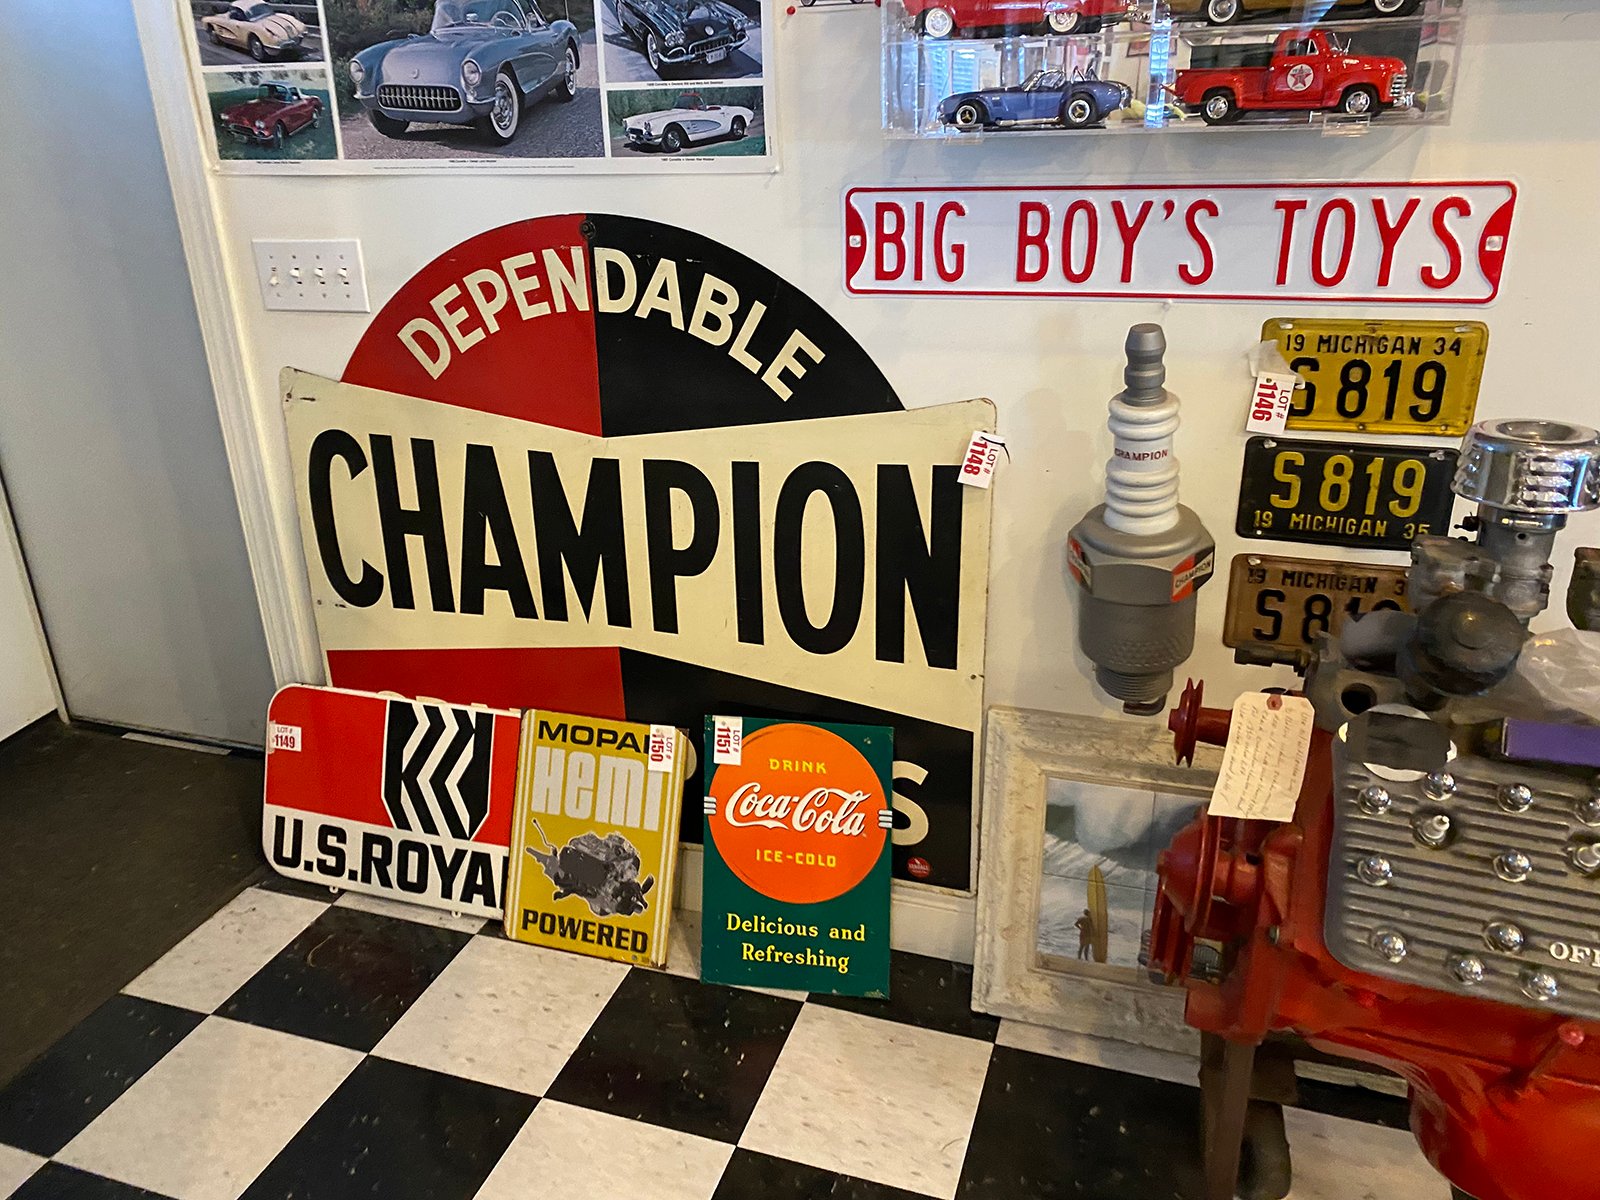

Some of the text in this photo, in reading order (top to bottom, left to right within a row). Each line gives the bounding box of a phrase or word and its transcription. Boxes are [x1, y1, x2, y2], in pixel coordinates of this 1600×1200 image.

[874, 197, 1473, 290] BIG BOY'S TOYS
[396, 245, 827, 403] DEPENDABLE
[1286, 333, 1462, 356] 19 MICHIGAN 34
[1252, 382, 1277, 423] 1146
[1277, 390, 1292, 412] LOT
[963, 441, 988, 476] 1148
[985, 448, 999, 468] LOT
[1253, 509, 1273, 528] 19
[1290, 513, 1388, 538] MICHIGAN
[308, 428, 964, 671] CHAMPION
[1281, 570, 1378, 594] MICHIGAN
[274, 734, 296, 749] 1149
[277, 726, 289, 734] LOT
[537, 719, 650, 754] MOPA
[716, 725, 731, 755] 1151
[768, 758, 828, 774] DRINK
[725, 782, 872, 837] Coca-Cola
[756, 849, 837, 868] ICE-COLD
[521, 908, 648, 954] POWERED
[726, 912, 866, 942] Delicious and
[741, 943, 850, 974] Refreshing
